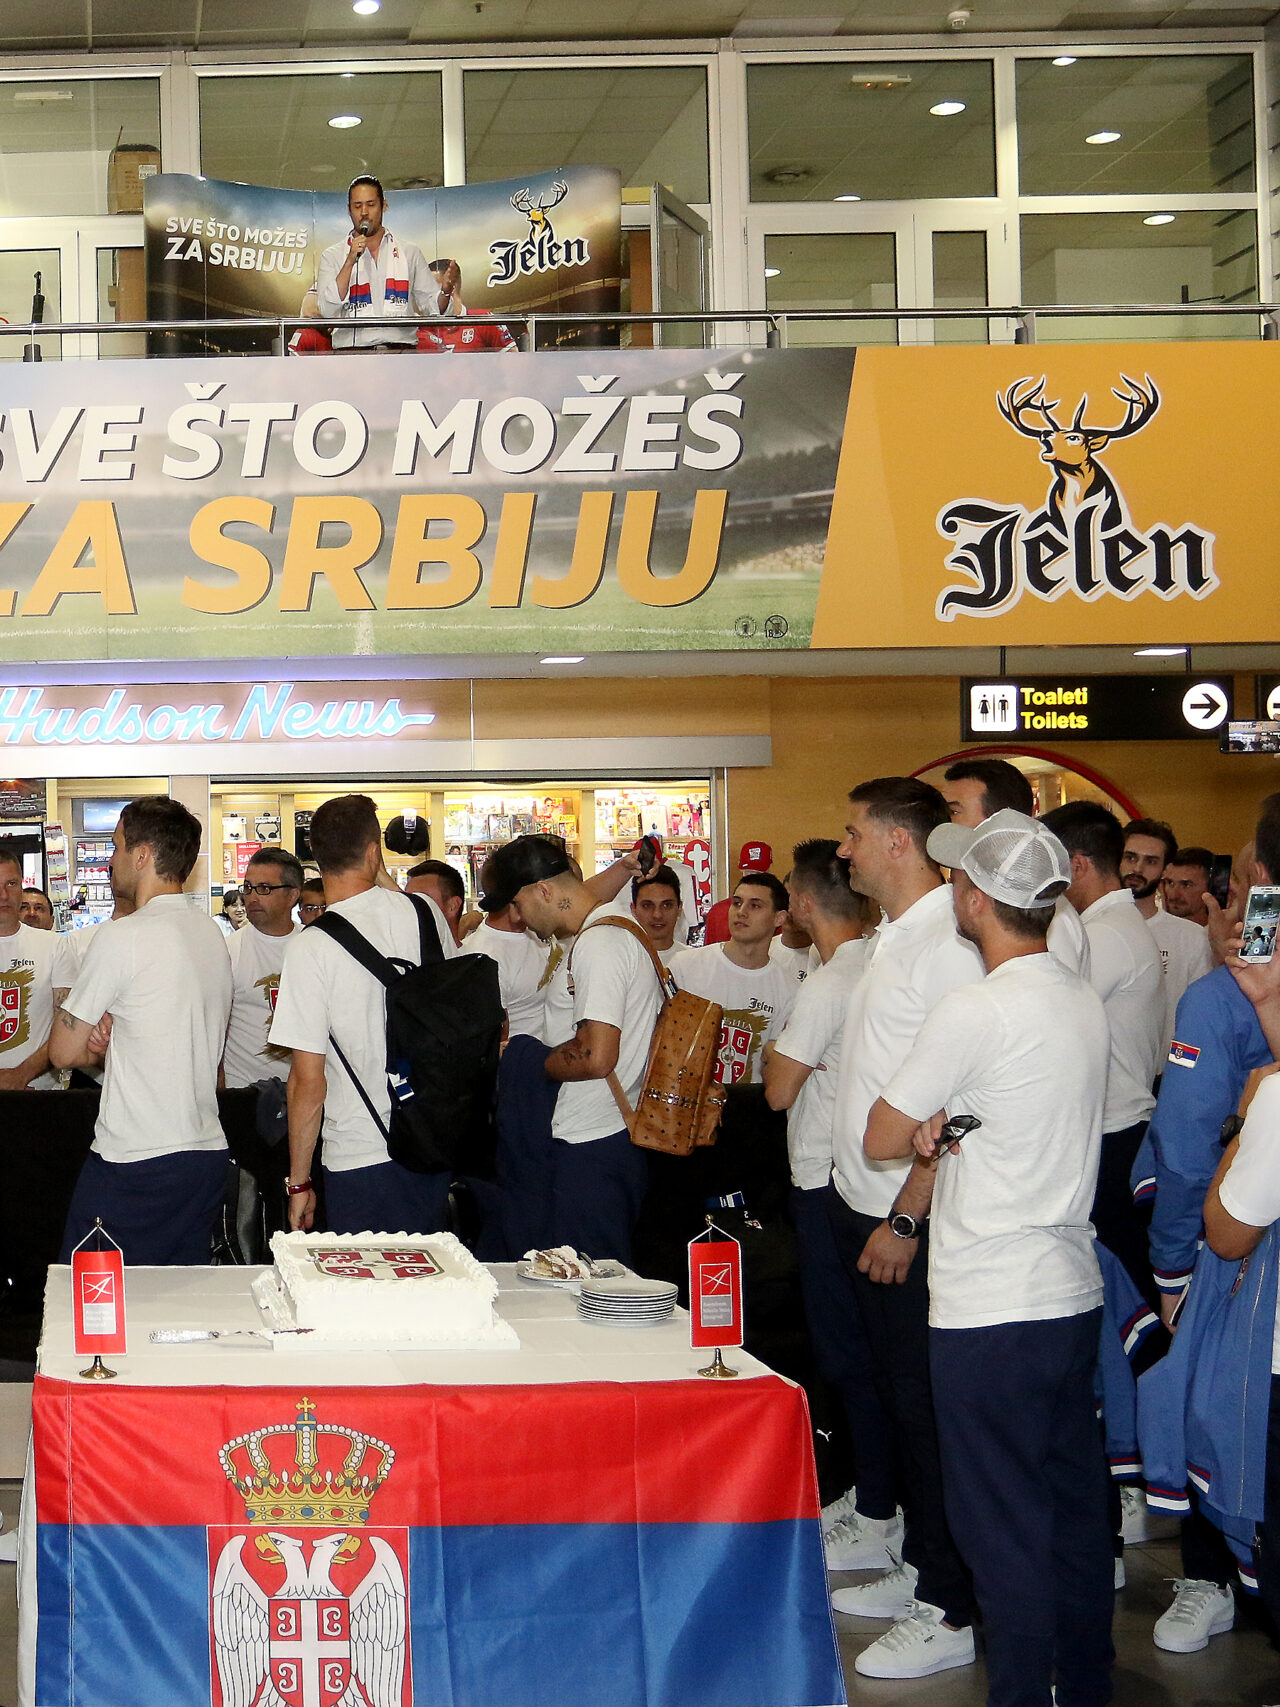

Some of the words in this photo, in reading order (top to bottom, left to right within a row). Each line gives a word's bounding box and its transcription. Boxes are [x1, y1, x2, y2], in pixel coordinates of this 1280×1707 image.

[165, 216, 204, 235] SVE
[206, 216, 241, 242] ŠTO
[243, 226, 309, 249] MOŽEŠ
[164, 237, 204, 263] ZA
[209, 242, 305, 275] SRBIJU!
[487, 234, 591, 287] Jelen
[162, 382, 368, 480] ŠTO
[392, 373, 746, 473] MOŽEŠ
[181, 489, 728, 615] SRBIJU
[935, 497, 1220, 622] Jelen
[230, 683, 436, 741] News
[1020, 687, 1088, 706] Toaleti
[1020, 711, 1089, 730] Toilets
[10, 958, 35, 968] Jelen
[748, 997, 775, 1014] Jelen
